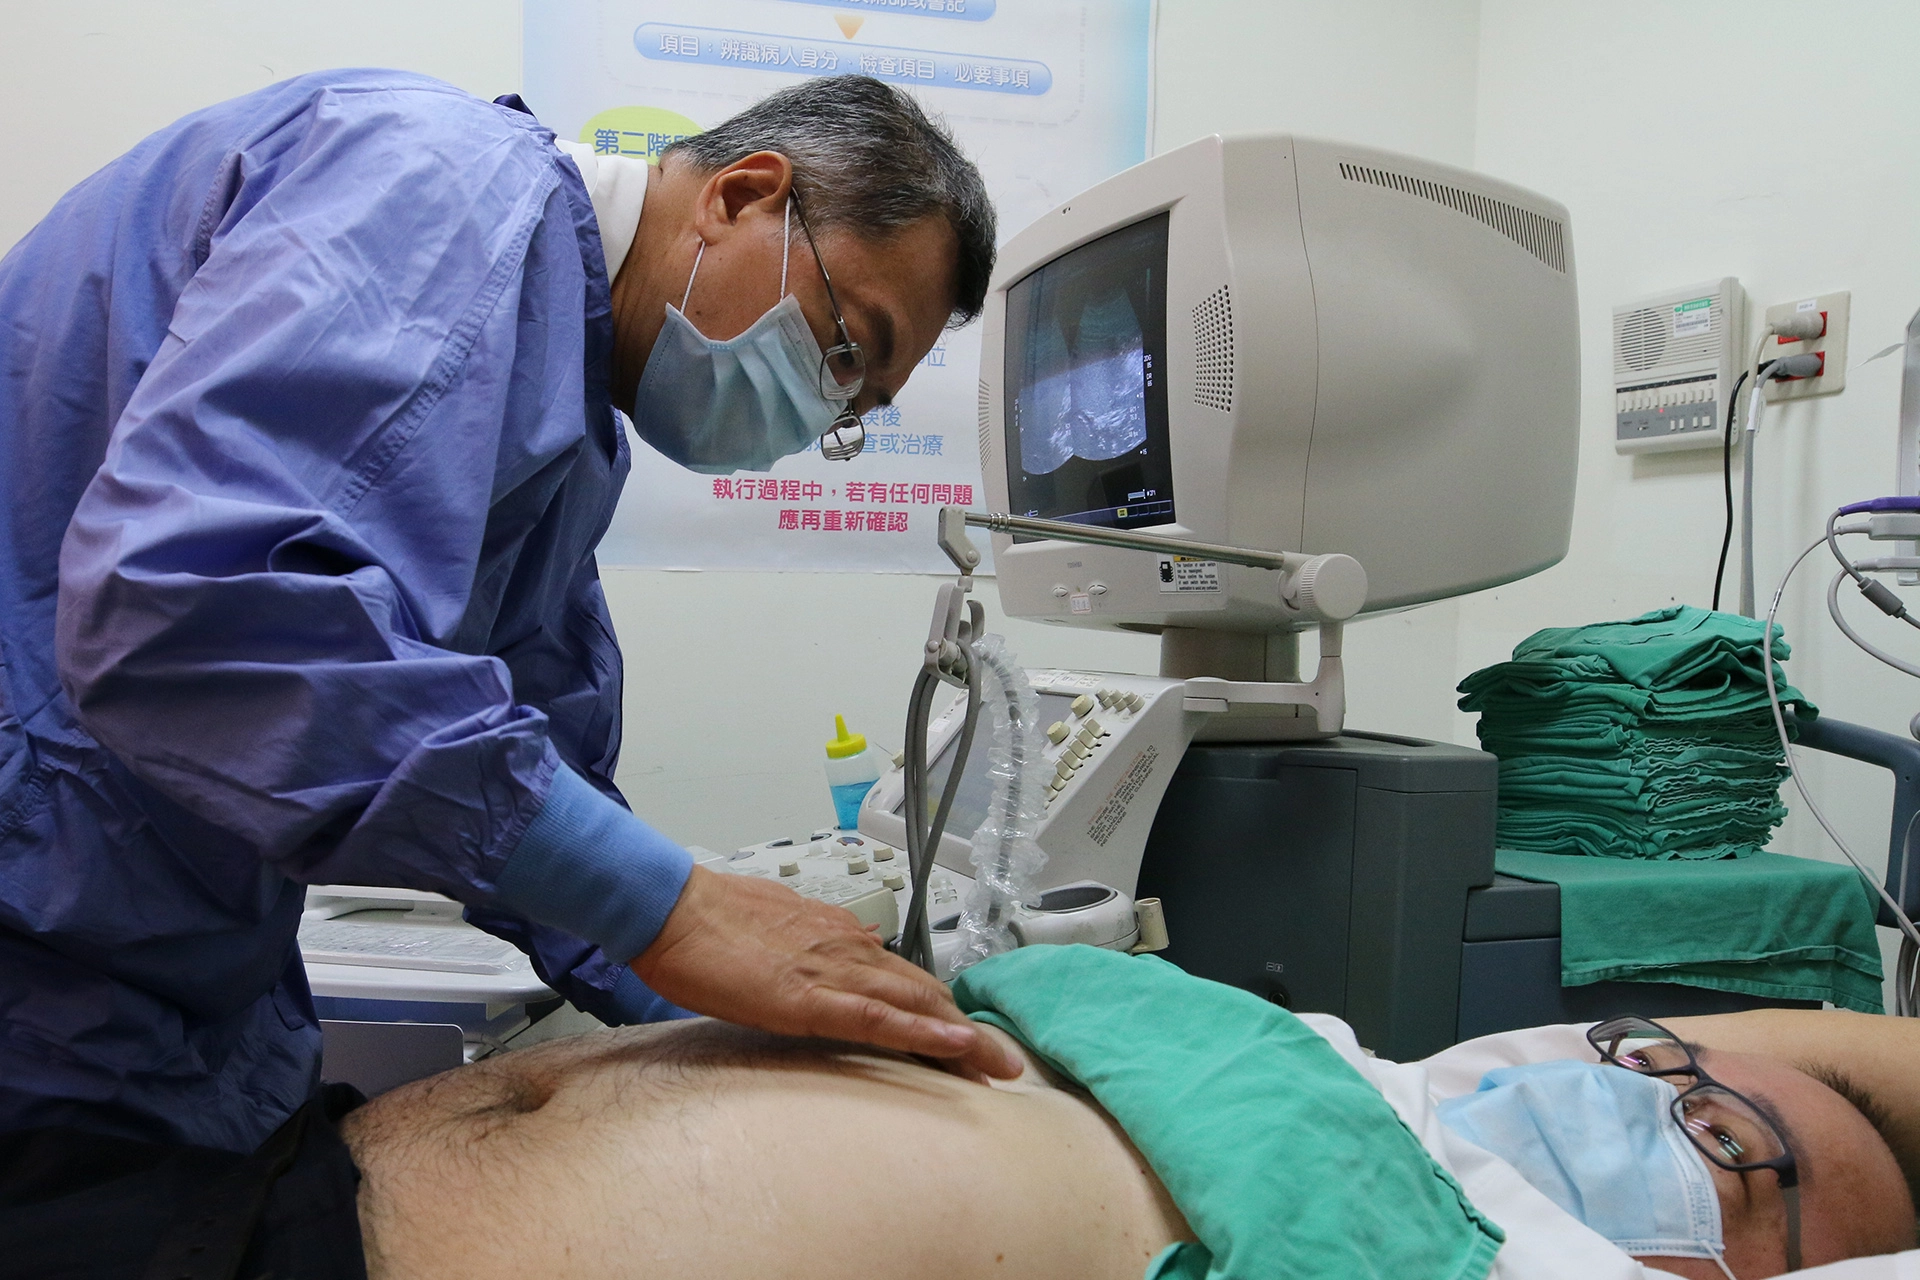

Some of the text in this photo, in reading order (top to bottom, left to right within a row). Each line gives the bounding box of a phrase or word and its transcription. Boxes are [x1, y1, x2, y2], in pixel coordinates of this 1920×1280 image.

[594, 129, 692, 157] 第二階
[713, 478, 973, 505] 執行過程中，若有任何問題
[778, 509, 908, 532] 應再重新確認
